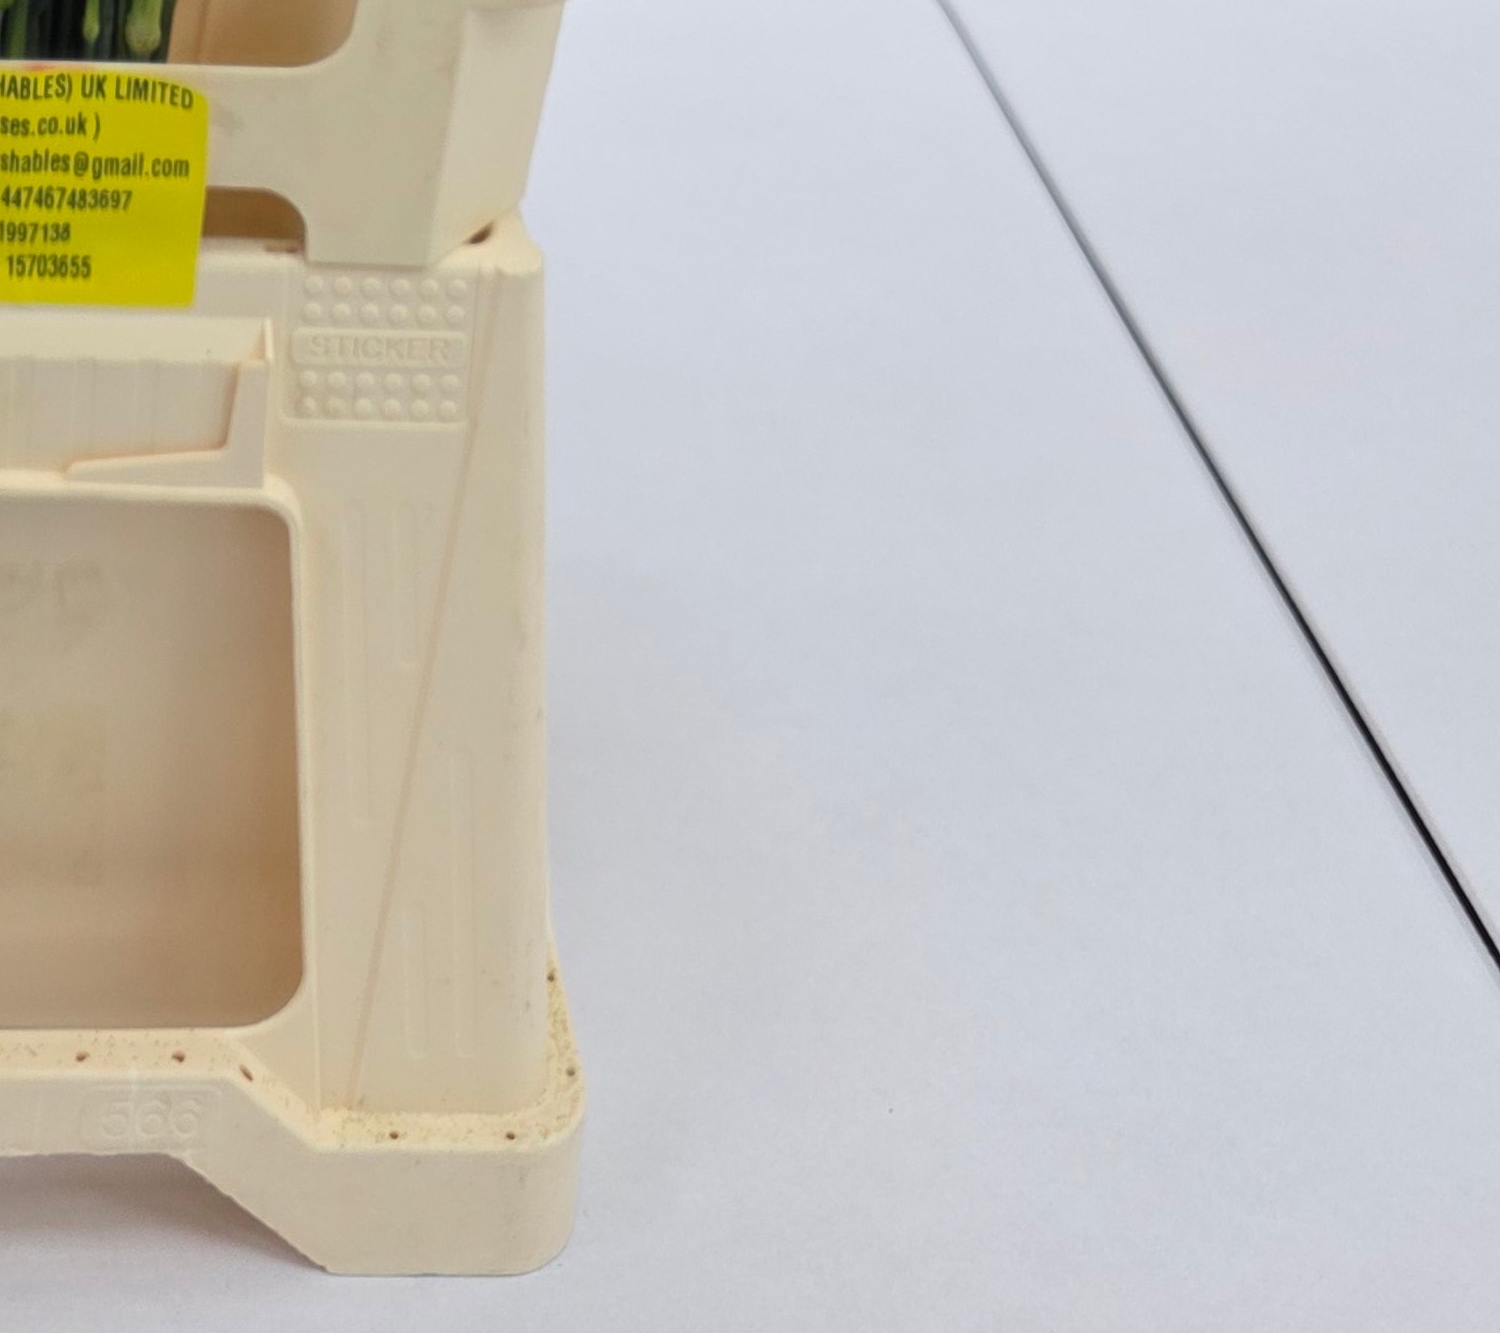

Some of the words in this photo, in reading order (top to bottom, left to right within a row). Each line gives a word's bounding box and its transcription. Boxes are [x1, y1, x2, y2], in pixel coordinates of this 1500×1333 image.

[81, 75, 107, 99] UK
[115, 76, 194, 110] LIMITED
[7, 254, 91, 279] 15703655
[311, 334, 454, 364] STICKER
